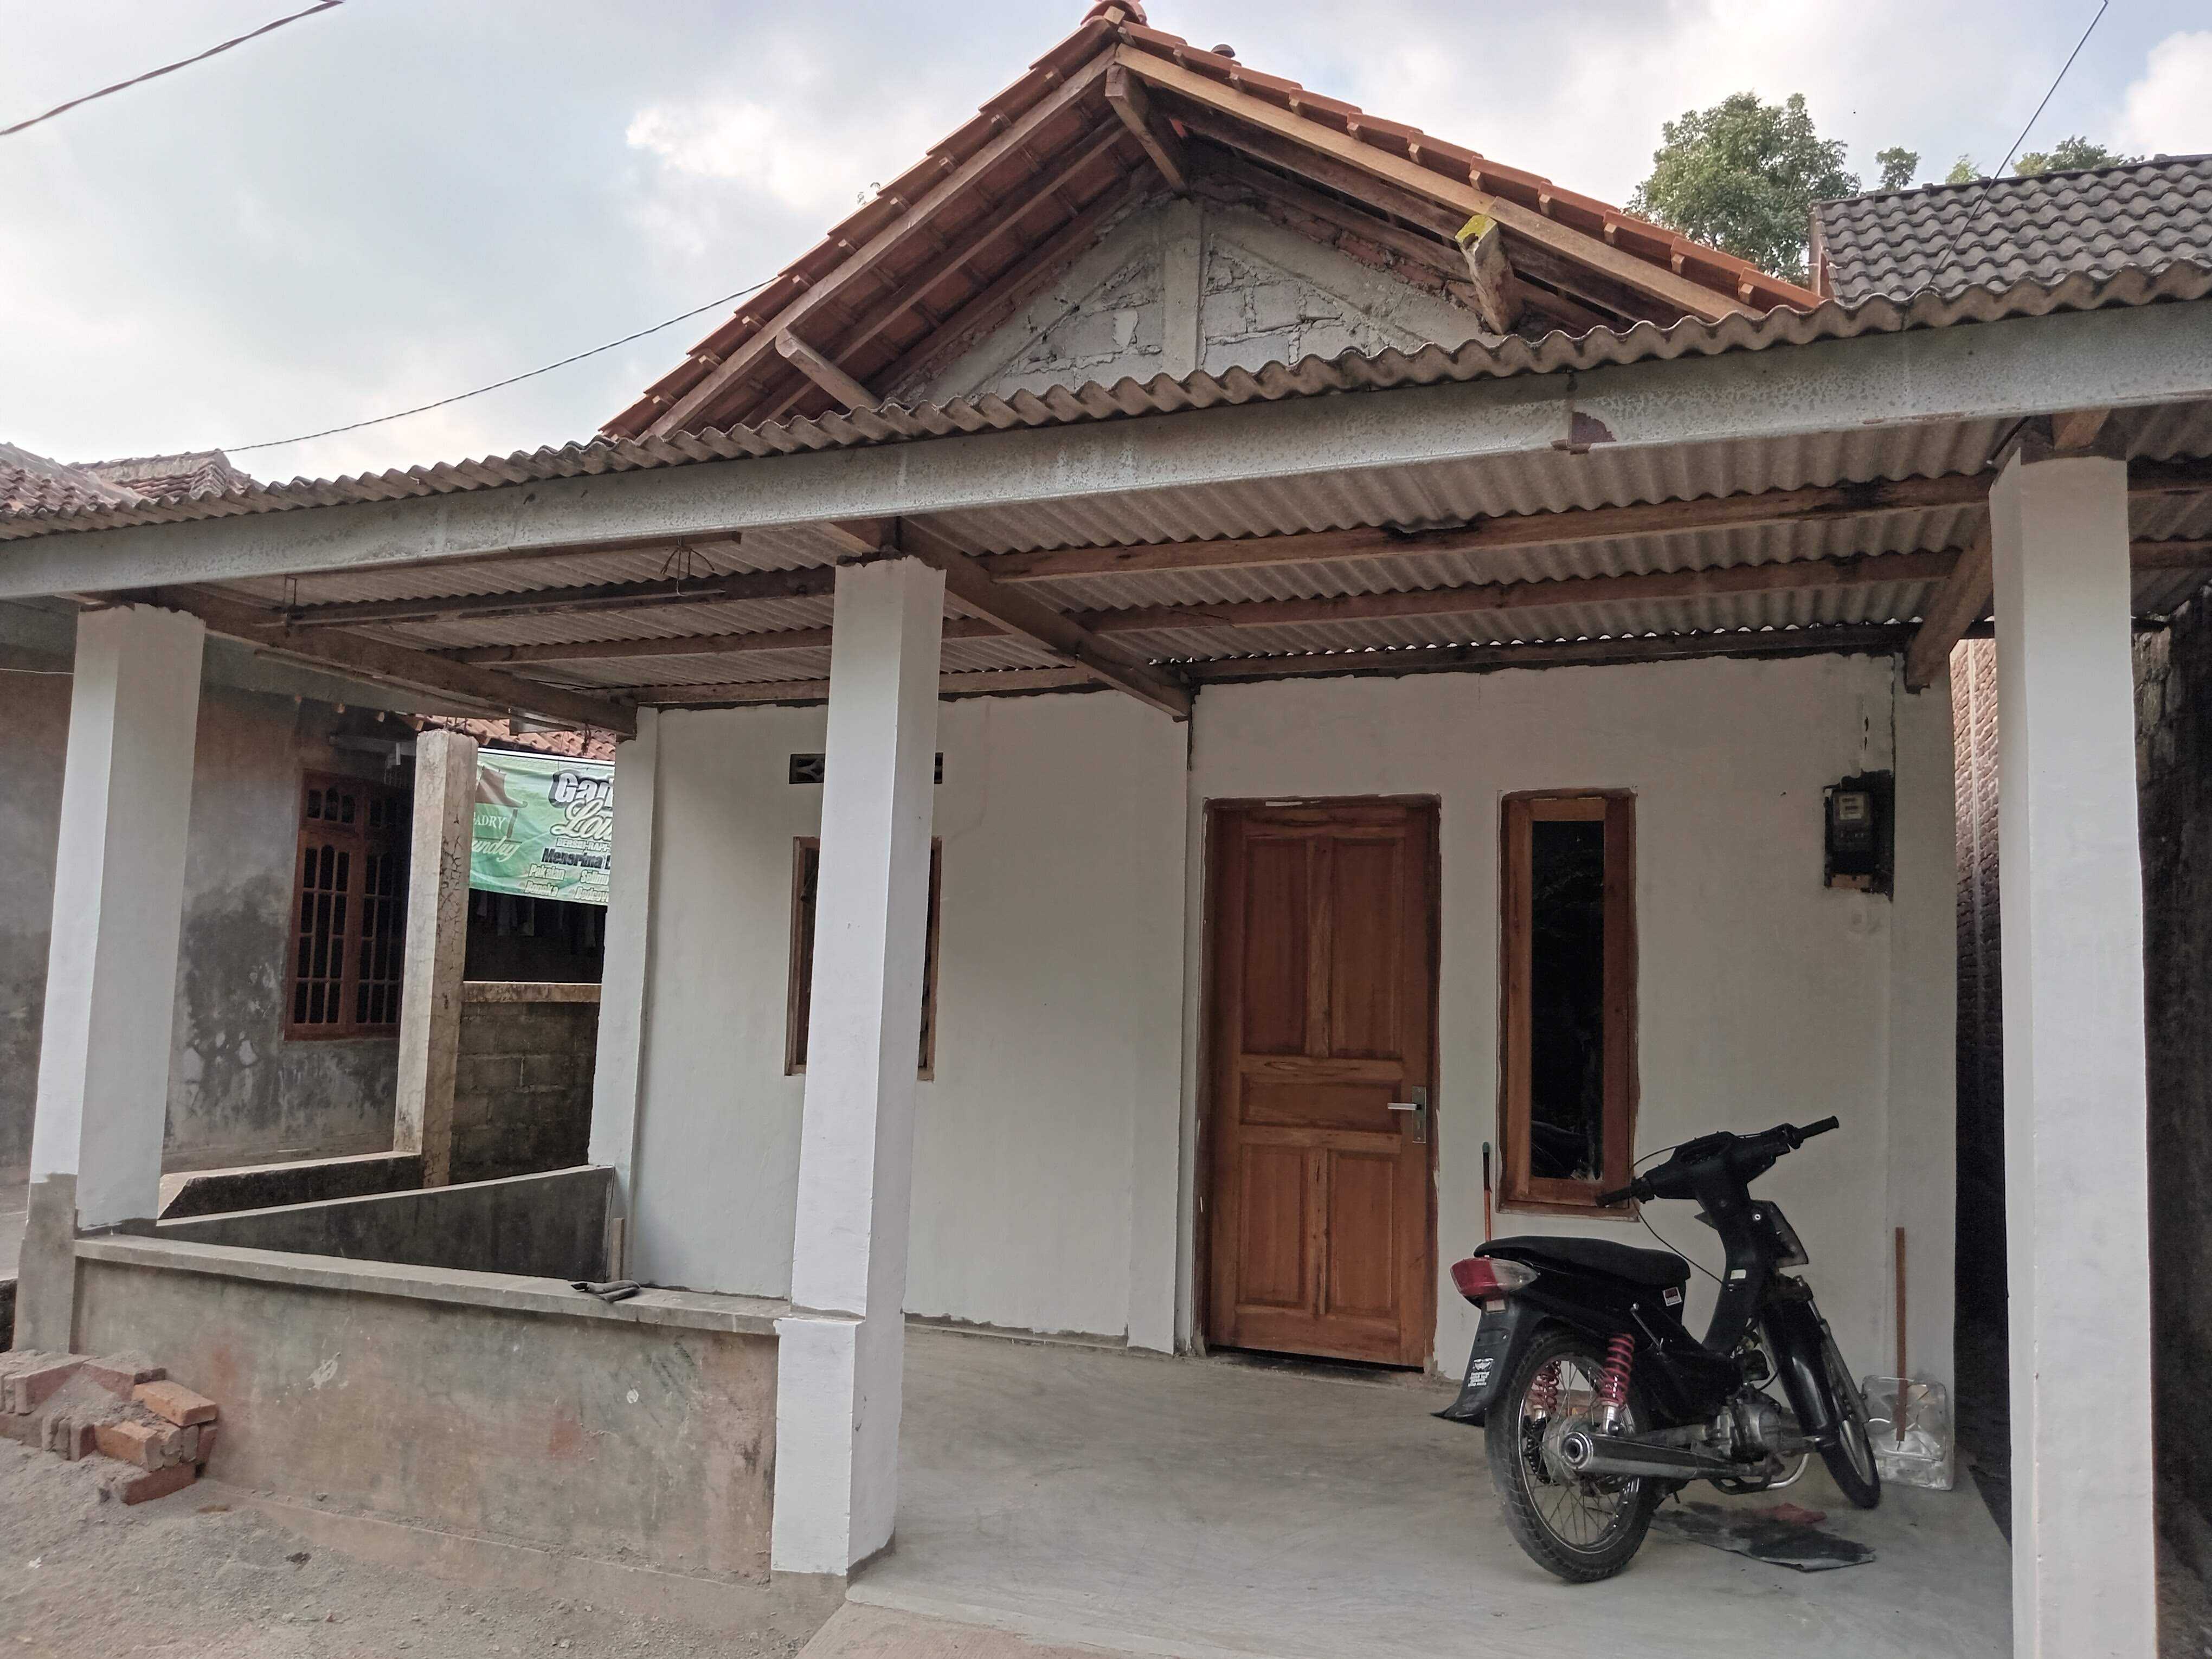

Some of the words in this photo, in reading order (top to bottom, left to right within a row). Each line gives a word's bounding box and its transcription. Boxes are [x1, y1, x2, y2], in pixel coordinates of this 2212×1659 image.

[473, 812, 507, 829] ADRY
[542, 847, 602, 869] Menerima
[529, 863, 565, 880] Pakaian
